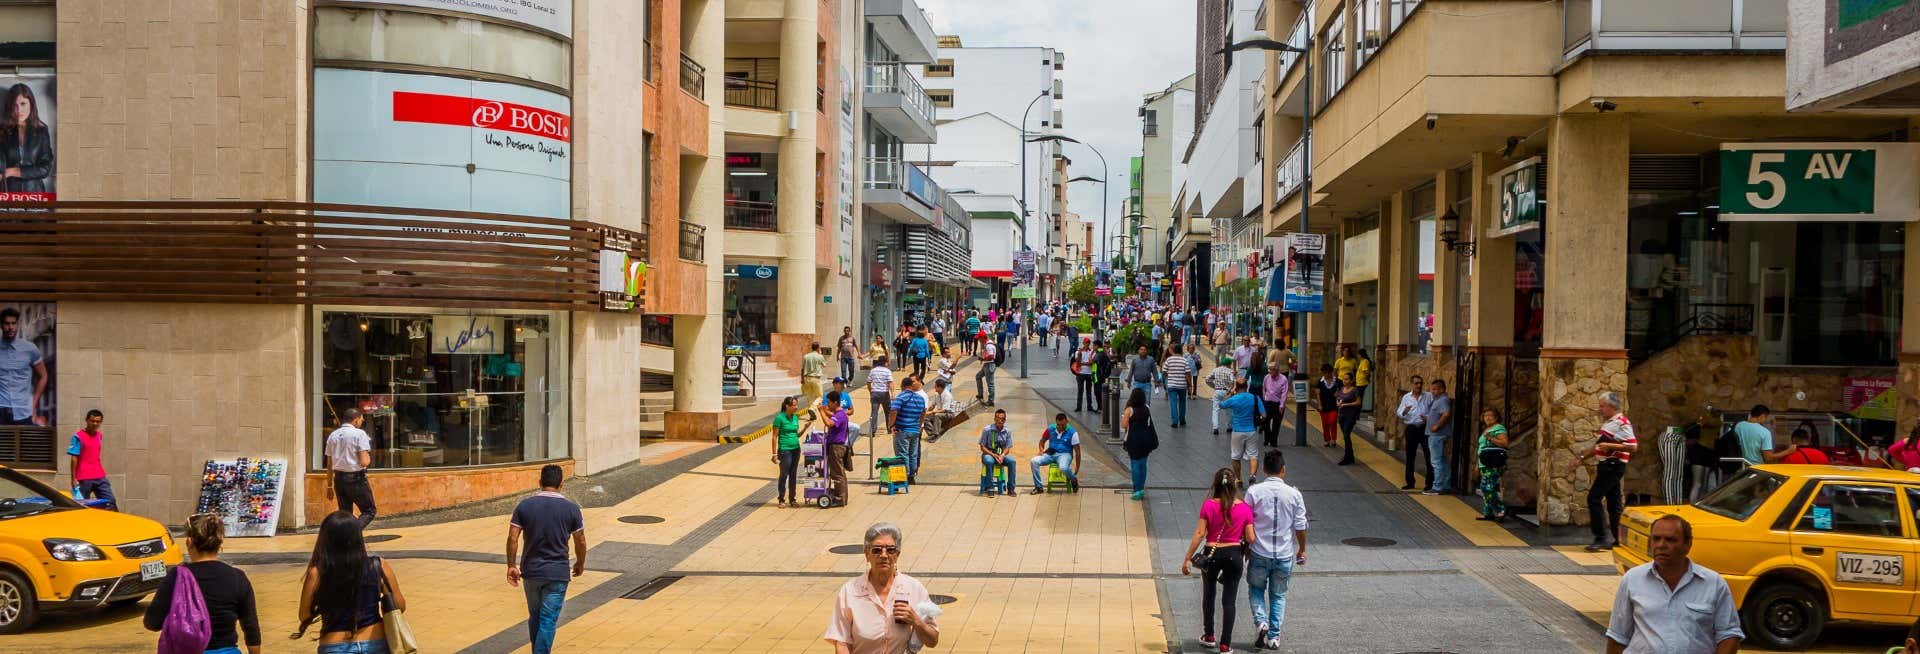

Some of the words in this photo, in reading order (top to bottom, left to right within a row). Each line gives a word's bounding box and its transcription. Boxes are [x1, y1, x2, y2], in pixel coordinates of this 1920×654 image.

[510, 107, 563, 137] BOSI
[485, 133, 503, 148] Una
[505, 135, 535, 153] Persona
[1745, 153, 1787, 209] 5
[1804, 153, 1852, 180] AV
